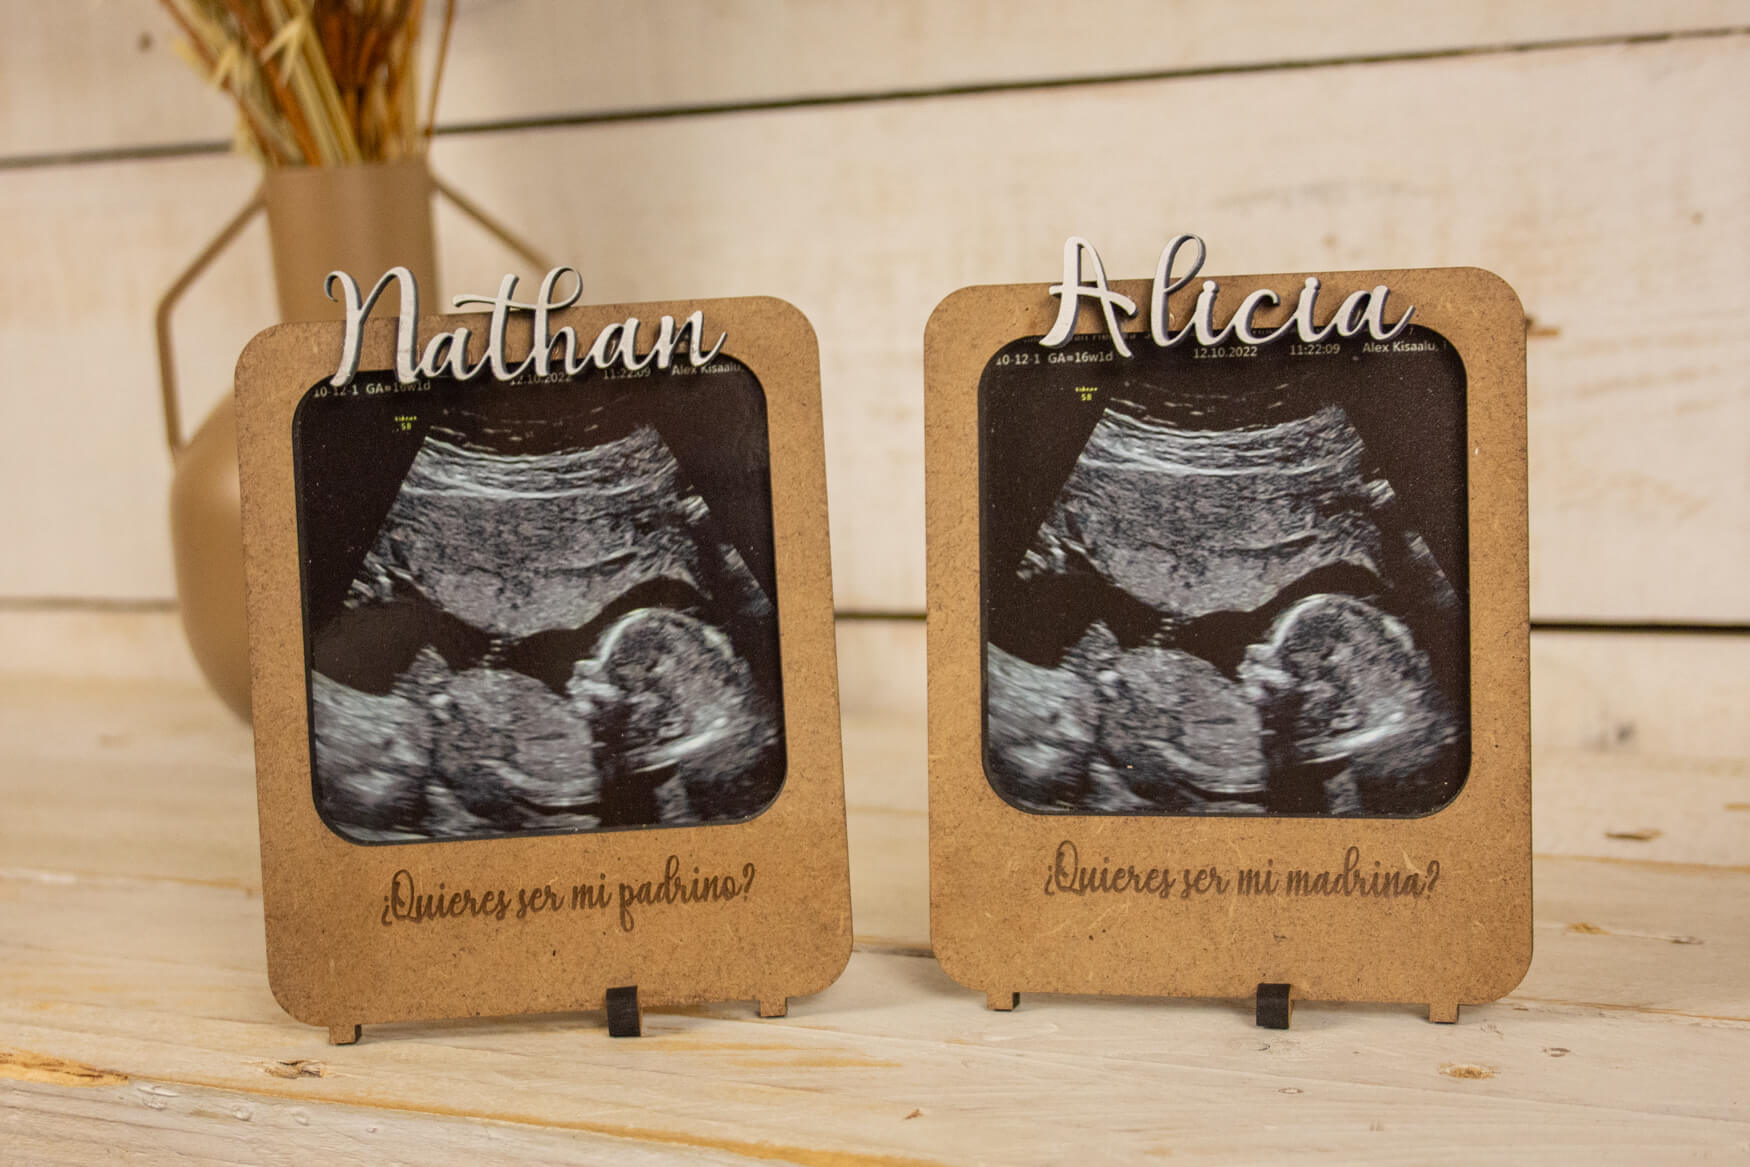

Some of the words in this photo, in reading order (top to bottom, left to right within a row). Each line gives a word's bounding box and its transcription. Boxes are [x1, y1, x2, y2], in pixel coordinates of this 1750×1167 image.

[324, 266, 728, 387] Nathan
[1039, 233, 1416, 358] Alicia
[1048, 351, 1114, 364] GA=16w1d
[1194, 346, 1258, 358] 12.10.2022
[1289, 343, 1341, 355] 11:22:09
[1362, 341, 1389, 353] Alex
[381, 869, 511, 926] ¿Quieres
[516, 884, 565, 919] ser
[571, 873, 612, 910] mi
[619, 855, 755, 932] padrino?
[1044, 840, 1175, 898] ¿Quieres
[1181, 863, 1229, 898] ser
[1237, 859, 1279, 897] mi
[1286, 846, 1440, 898] madrina?
